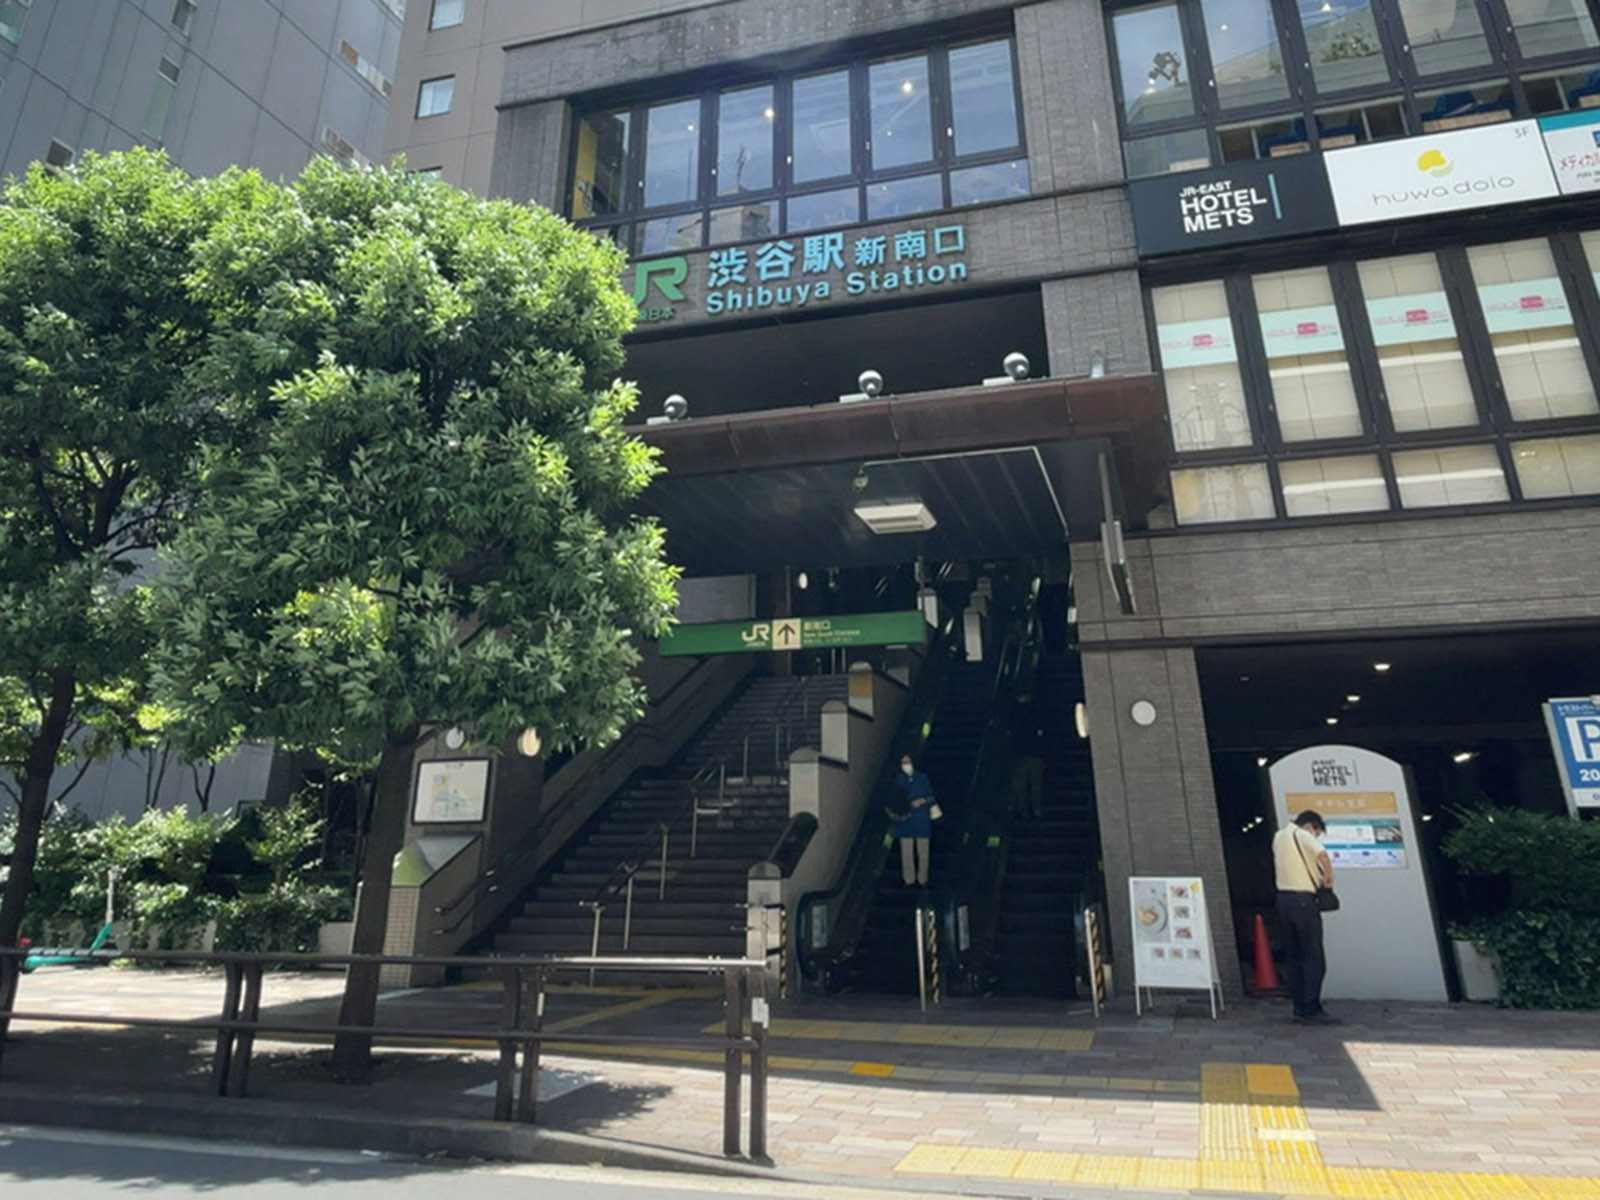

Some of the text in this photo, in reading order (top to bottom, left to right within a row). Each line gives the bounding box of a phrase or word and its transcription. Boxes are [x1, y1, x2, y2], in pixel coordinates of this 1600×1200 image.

[1179, 180, 1232, 198] JR-EAST
[1180, 187, 1268, 215] HOTEL
[1183, 207, 1254, 233] METS
[707, 225, 965, 288] 渋谷駅 新南口
[705, 261, 968, 314] Shibuya Station
[741, 624, 770, 642] JR
[1311, 765, 1352, 777] HOTEL
[1313, 776, 1347, 787] METS
